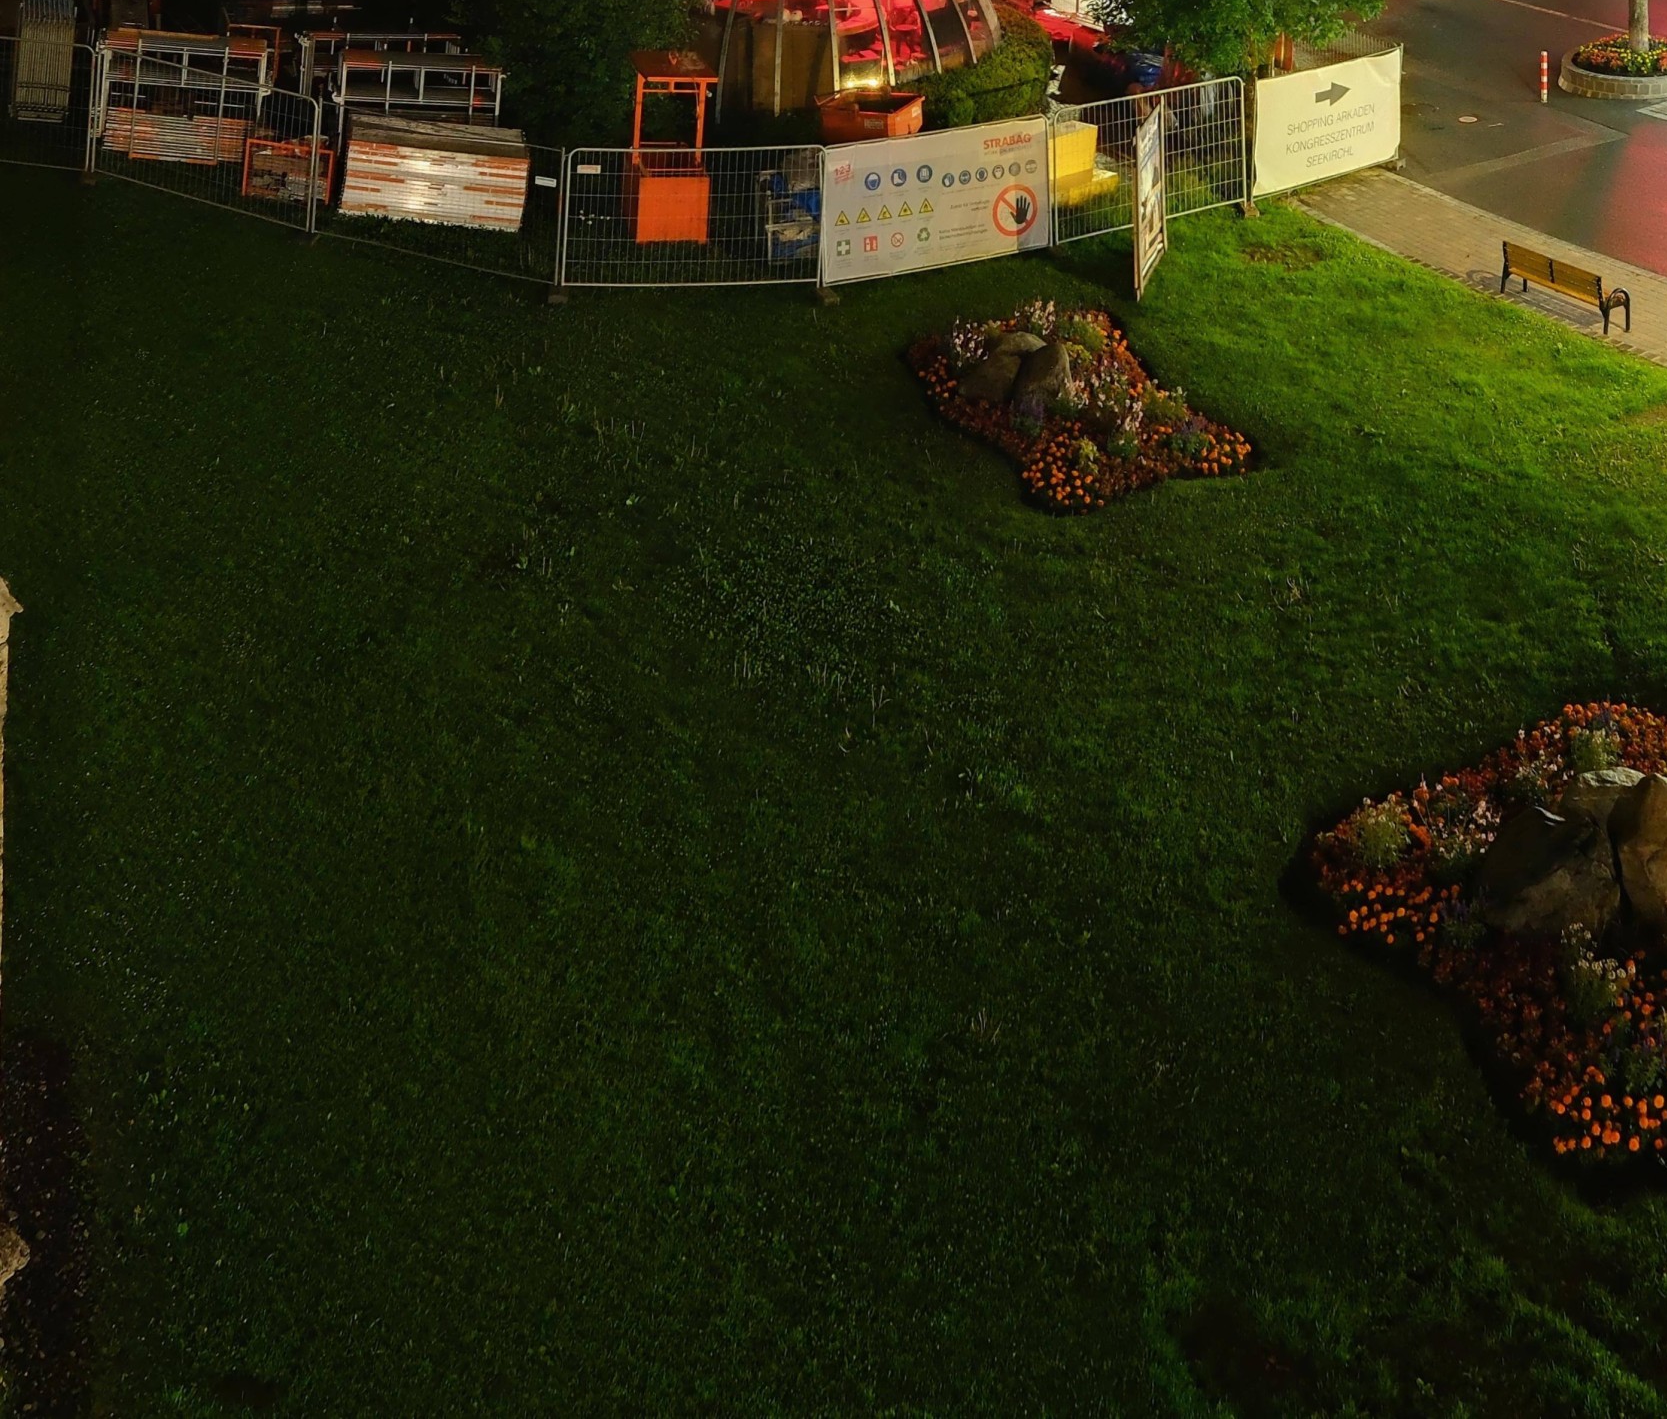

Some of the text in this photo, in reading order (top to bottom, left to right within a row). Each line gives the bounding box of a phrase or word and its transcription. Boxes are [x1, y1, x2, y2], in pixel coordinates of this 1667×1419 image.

[1287, 103, 1375, 136] SHOPPING ARKADEN
[983, 133, 1032, 150] STRABAG
[1286, 121, 1375, 155] KONGRESSZENTRUM
[1305, 147, 1354, 168] SEEKIRCHL
